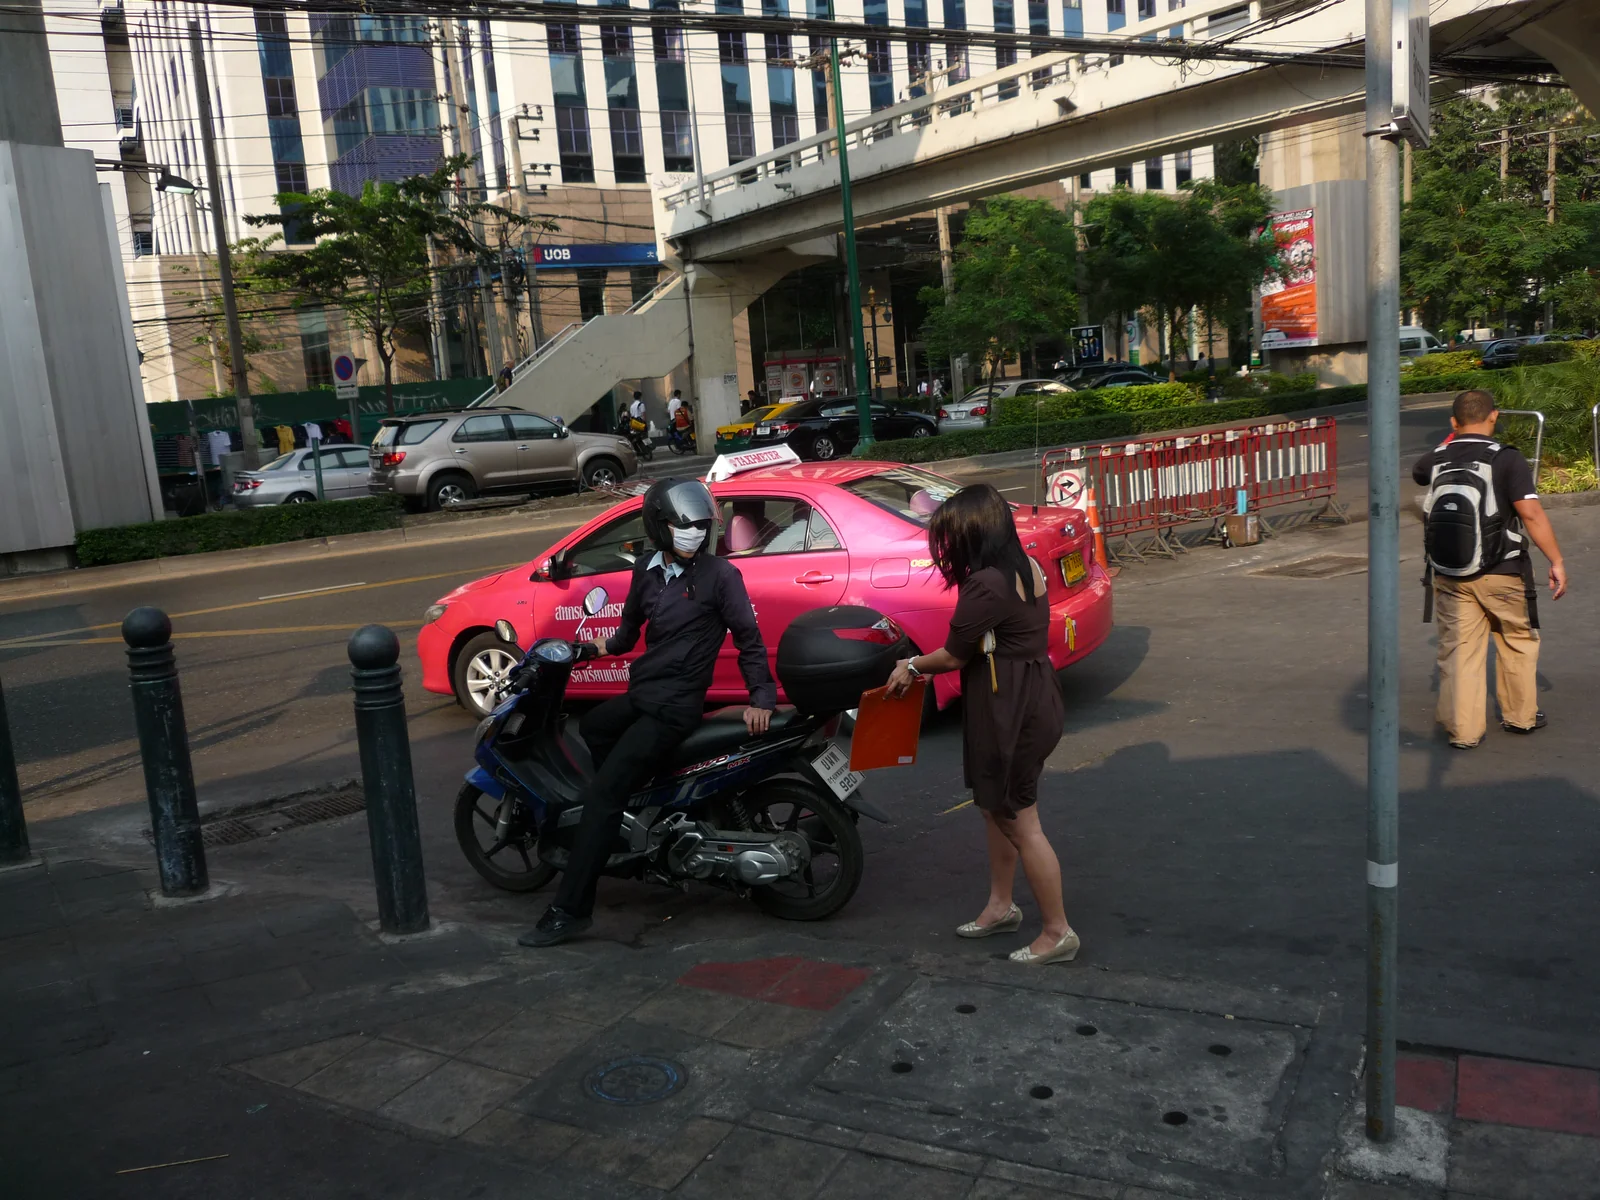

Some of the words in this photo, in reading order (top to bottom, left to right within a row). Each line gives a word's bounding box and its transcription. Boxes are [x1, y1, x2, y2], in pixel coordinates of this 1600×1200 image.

[1284, 220, 1309, 232] Finale
[544, 248, 571, 260] UOB
[735, 450, 782, 466] TAXI-METER
[839, 772, 858, 792] 920
